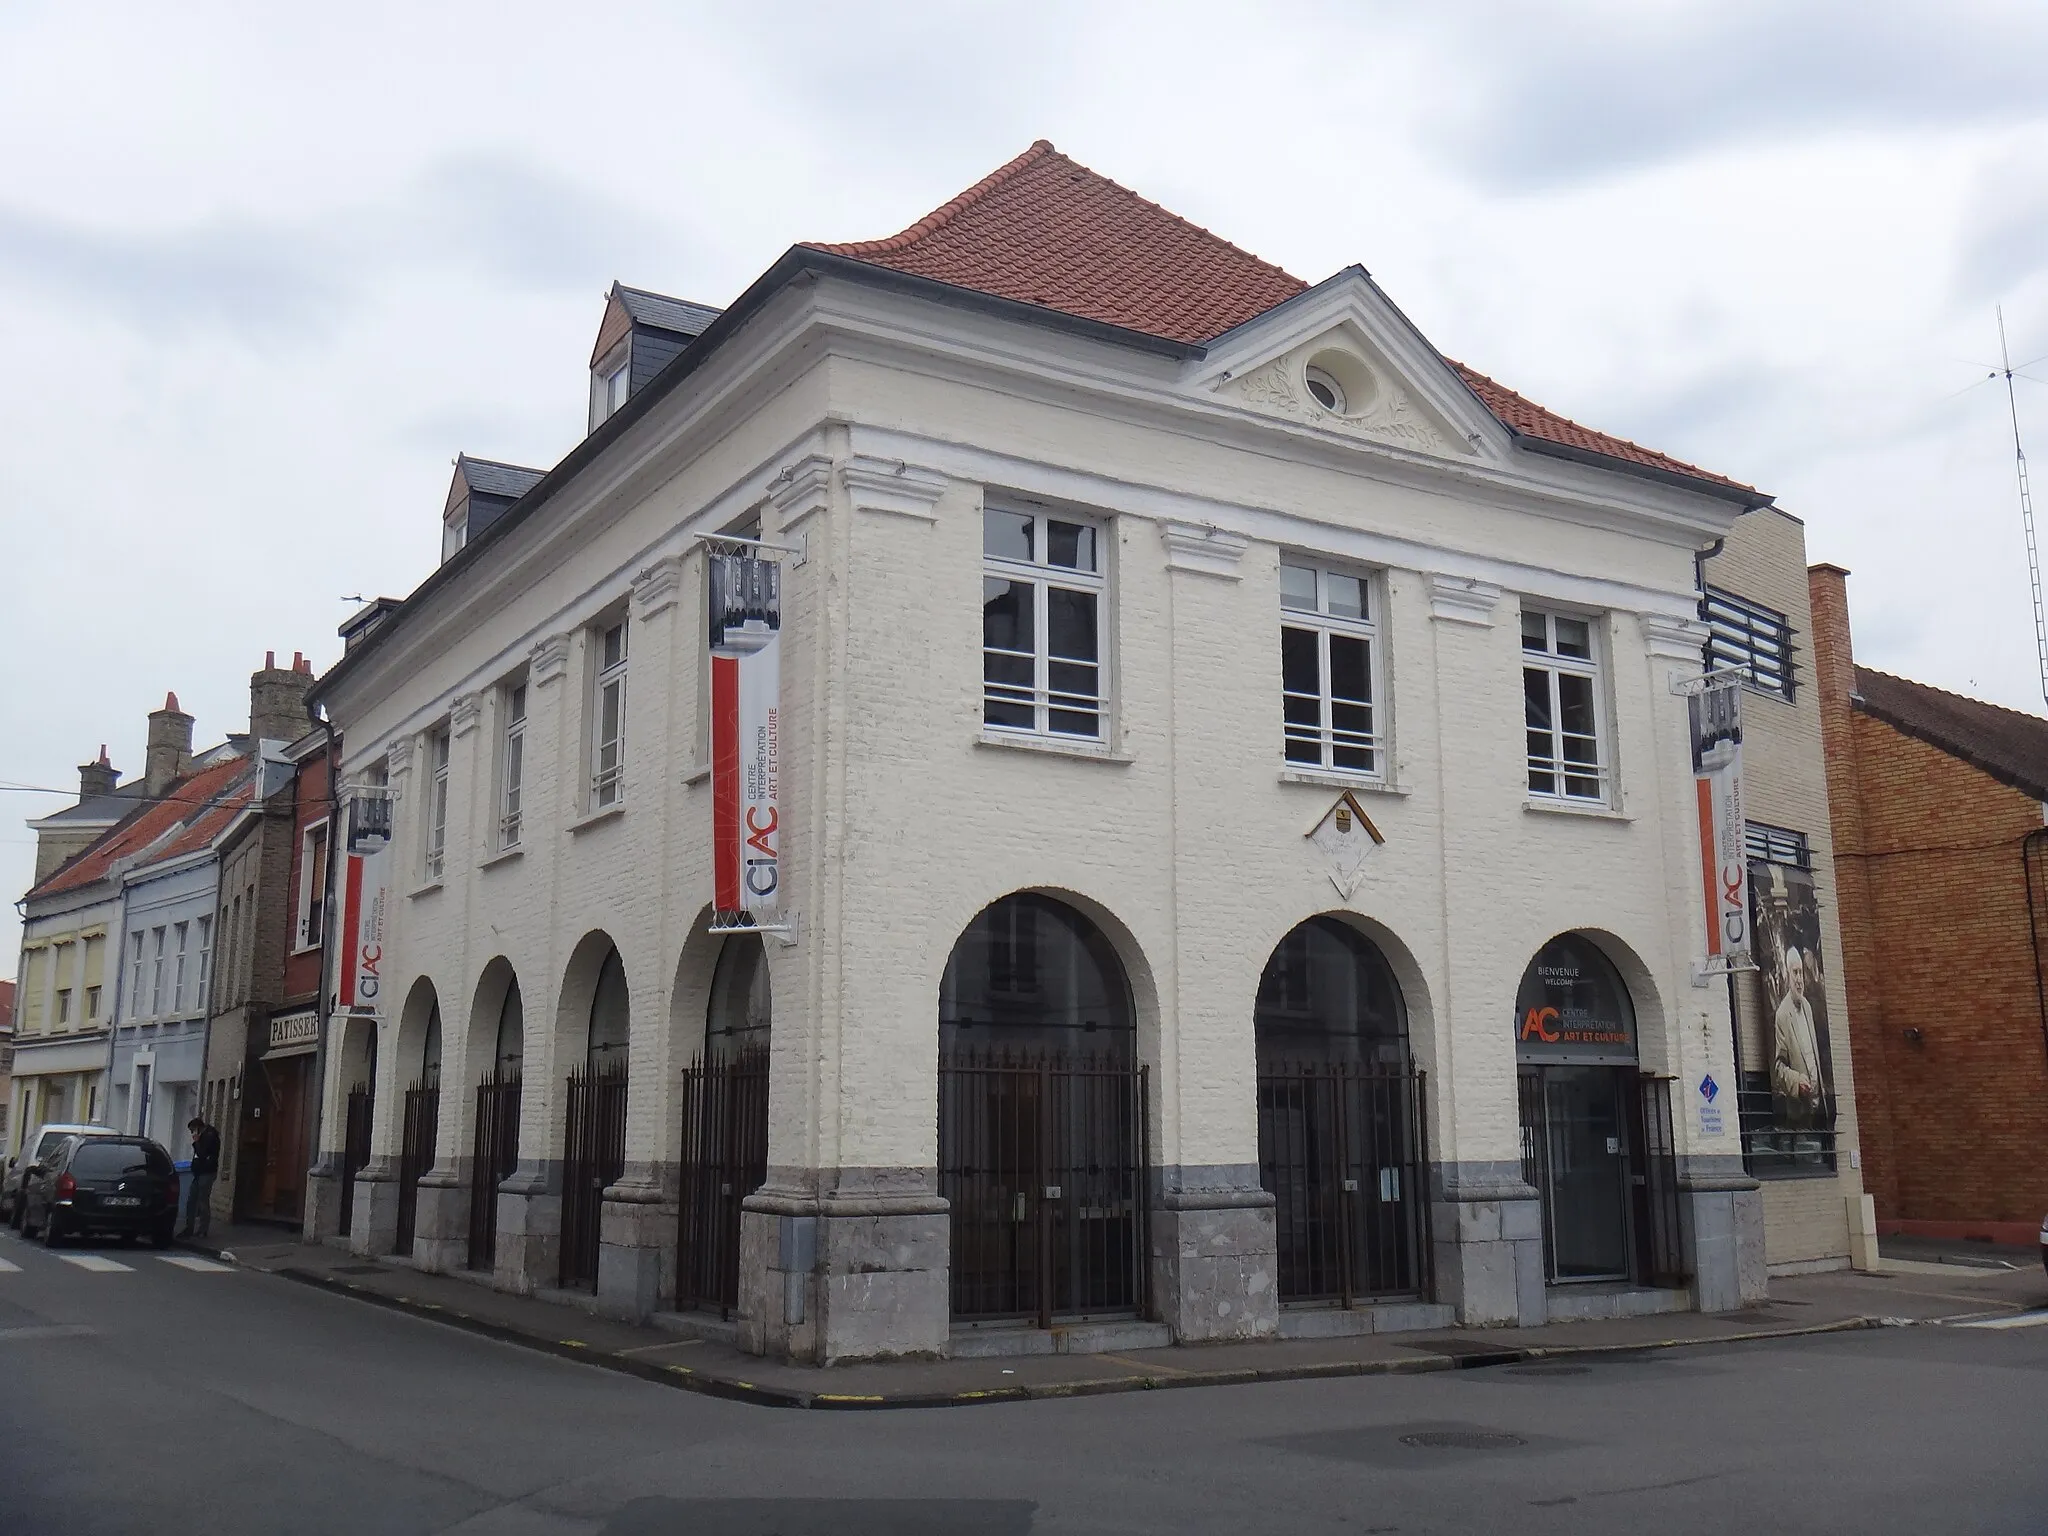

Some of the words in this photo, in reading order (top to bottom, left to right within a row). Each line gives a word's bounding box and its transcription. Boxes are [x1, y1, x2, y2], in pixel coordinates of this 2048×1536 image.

[769, 707, 777, 756] CULTURE
[756, 726, 766, 800] INTERPRÉTATION
[769, 759, 778, 773] ET
[748, 763, 756, 800] CENTRE
[769, 777, 778, 800] ART
[1733, 777, 1741, 820] CULTURE
[1735, 823, 1741, 834] ET
[378, 887, 386, 916] CULTURE
[378, 917, 384, 927] ET
[1537, 966, 1579, 977] BIENVENUE
[1545, 978, 1573, 986] WELCOME
[1562, 1008, 1588, 1018] CENTRE
[272, 1016, 317, 1042] PATISSER
[1564, 1032, 1581, 1041] ART
[1583, 1032, 1594, 1042] ET
[1594, 1032, 1631, 1043] CULTURE
